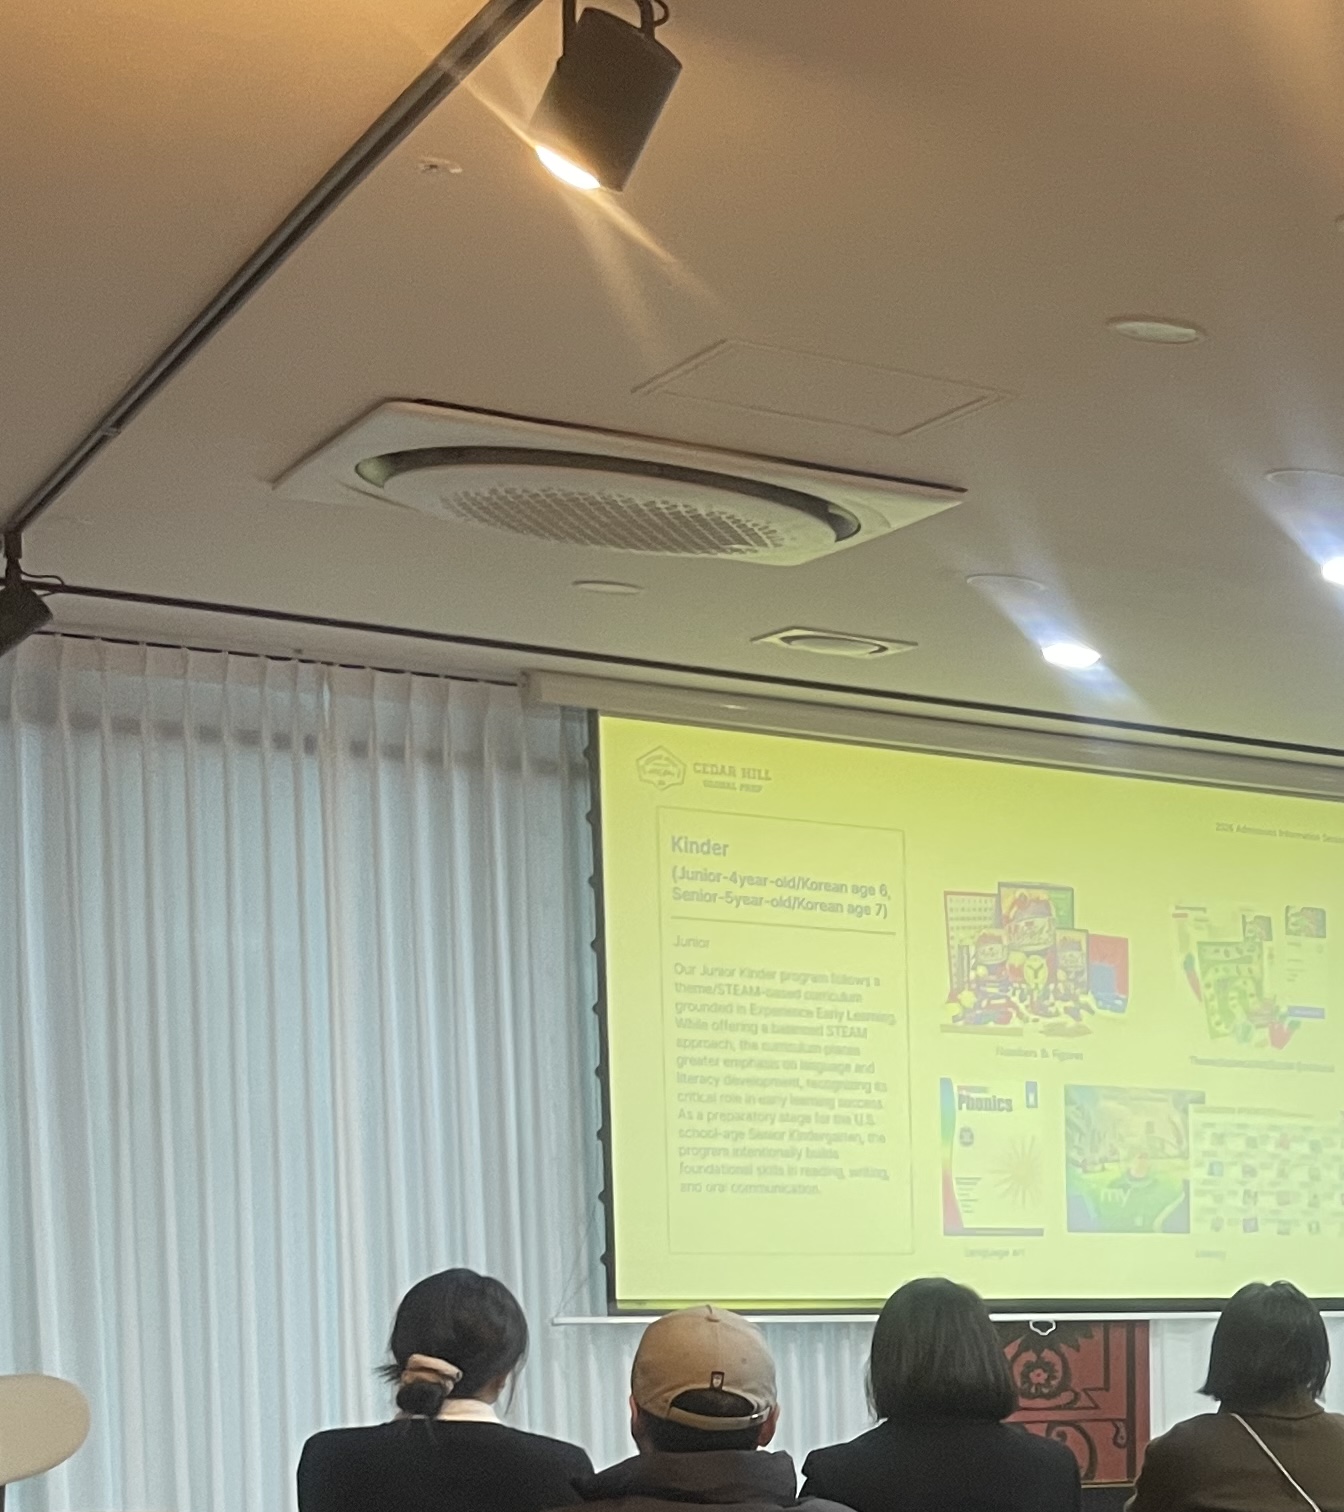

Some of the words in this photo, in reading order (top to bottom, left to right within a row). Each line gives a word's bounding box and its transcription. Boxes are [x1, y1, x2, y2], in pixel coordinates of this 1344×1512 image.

[693, 762, 736, 778] CEDAR
[741, 766, 772, 780] HILL
[671, 836, 729, 857] Kinder
[672, 865, 847, 893] (Junior-4year-old/Korean
[851, 884, 876, 898] age
[672, 887, 843, 913] Senior-5year-old/Korean
[847, 903, 871, 918] age
[876, 902, 887, 919] 7)
[673, 936, 709, 948] Junior
[674, 962, 696, 976] Our
[700, 964, 736, 977] Junior
[740, 966, 776, 980] Kinder
[780, 970, 828, 985] program
[873, 977, 880, 987] a
[804, 990, 862, 1003] curriculum
[675, 1000, 733, 1016] grounded
[737, 1003, 746, 1014] in
[750, 1003, 813, 1018] Experience
[816, 1007, 844, 1022] Early
[675, 1018, 708, 1031] While
[711, 1020, 758, 1035] offering
[761, 1025, 768, 1034] a
[826, 1026, 867, 1039] STEAM
[676, 1038, 736, 1053] approach,
[739, 1039, 758, 1051] the
[761, 1042, 821, 1054] curriculum
[676, 1055, 719, 1069] greater
[723, 1057, 779, 1072] emphasis
[782, 1060, 797, 1071] on
[854, 1062, 875, 1074] and
[677, 1071, 720, 1086] literacy
[724, 1074, 802, 1089] development,
[677, 1090, 717, 1104] critical
[719, 1092, 742, 1104] role
[744, 1093, 756, 1104] in
[758, 1094, 788, 1108] early
[958, 1093, 1013, 1112] Phonics
[678, 1108, 693, 1120] As
[697, 1112, 704, 1120] a
[707, 1110, 776, 1125] preparatory
[779, 1113, 811, 1125] stage
[814, 1112, 830, 1124] for
[833, 1113, 851, 1125] the
[678, 1127, 745, 1141] school-age
[748, 1128, 786, 1140] Senior
[867, 1132, 885, 1143] the
[678, 1146, 729, 1160] program
[732, 1146, 802, 1161] intentionally
[805, 1147, 839, 1160] builds
[680, 1161, 753, 1175] foundational
[756, 1163, 785, 1176] skills
[787, 1164, 798, 1176] in
[681, 1182, 702, 1193] and
[731, 1183, 822, 1195] communication.
[1100, 1188, 1130, 1208] my
